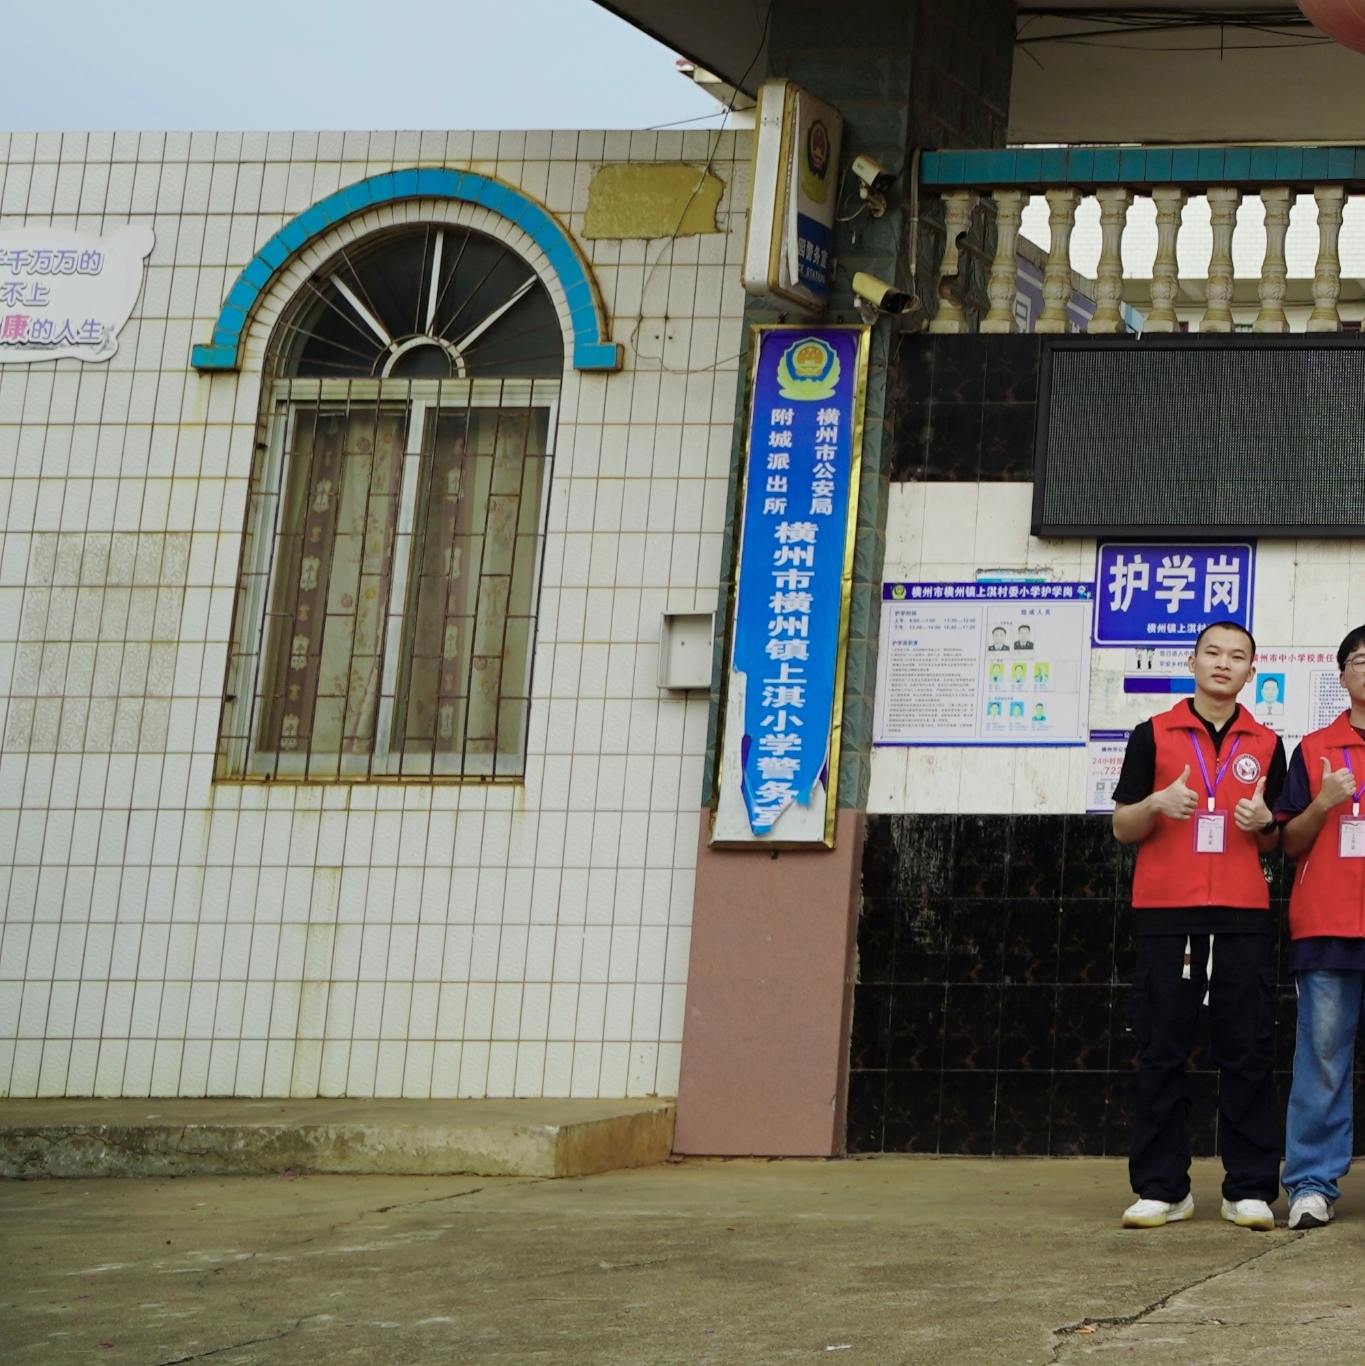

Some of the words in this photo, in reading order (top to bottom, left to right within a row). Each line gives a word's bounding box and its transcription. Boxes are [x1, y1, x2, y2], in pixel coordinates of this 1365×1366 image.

[0, 249, 101, 272] 千万万的
[763, 408, 795, 516] 附城派出所
[809, 408, 841, 516] 横州市公安局
[911, 585, 1073, 598] 横州市横州镇上淇村委小学护学岗
[1108, 553, 1241, 614] 护学岗
[1147, 622, 1208, 634] 横州镇上淇村
[1253, 653, 1335, 663] 横州市中小学校责任
